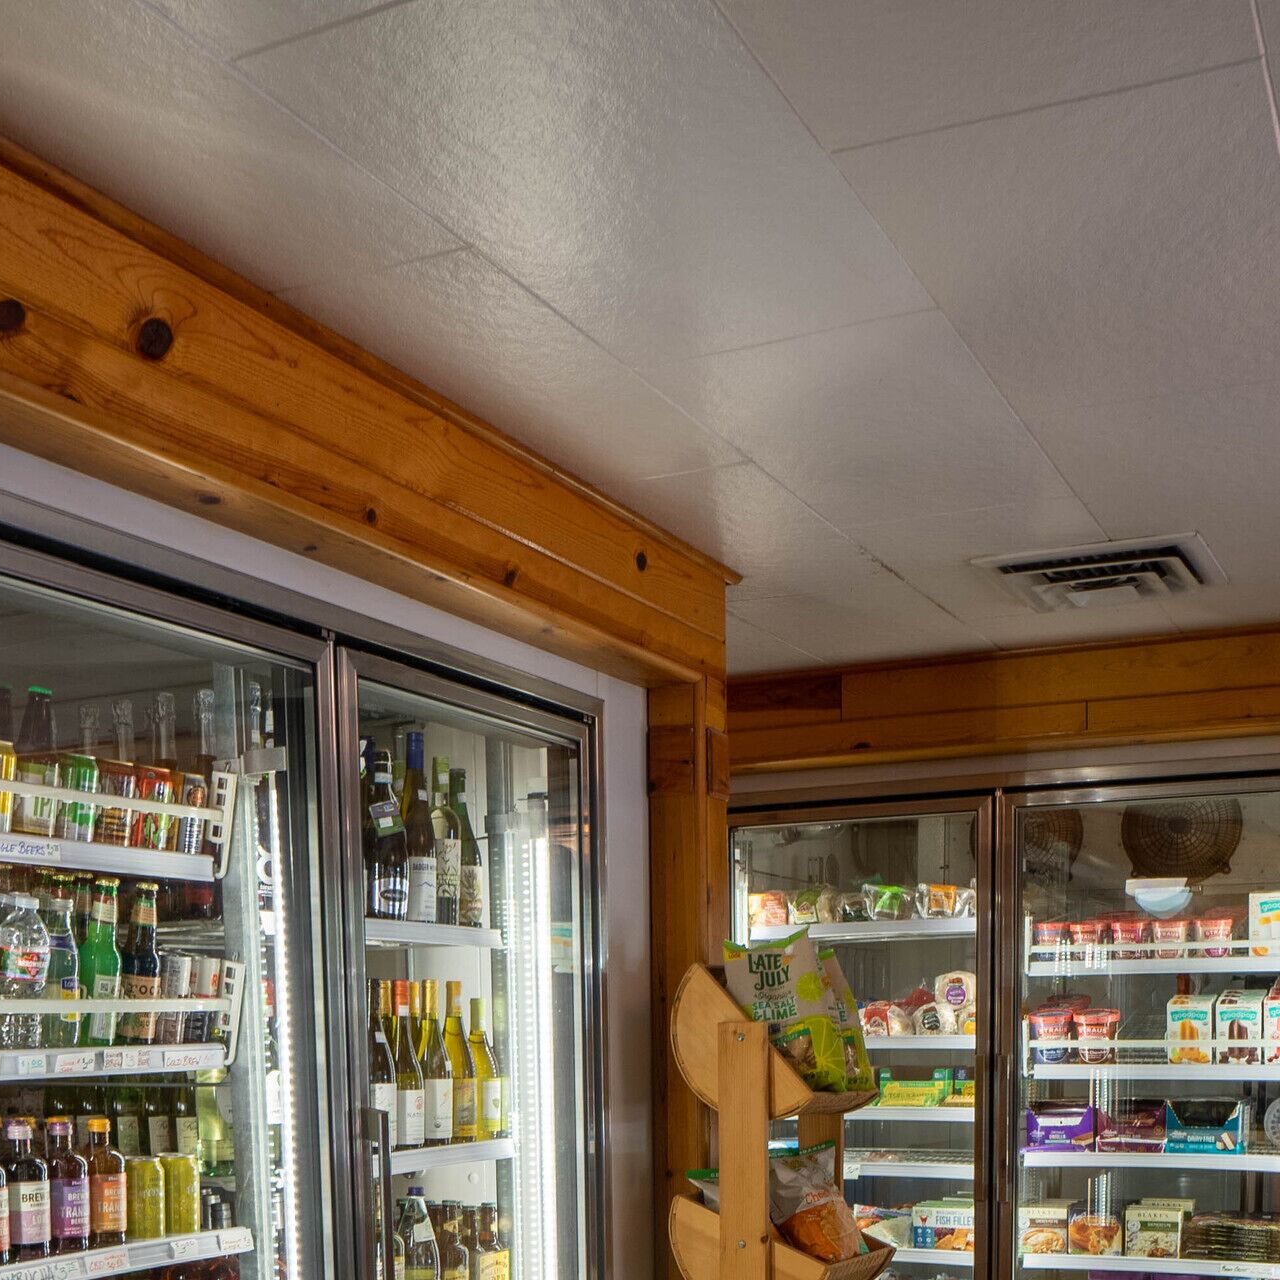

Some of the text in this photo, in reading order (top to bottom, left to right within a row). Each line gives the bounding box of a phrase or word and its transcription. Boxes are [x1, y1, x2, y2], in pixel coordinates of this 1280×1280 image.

[18, 843, 46, 856] BEERS
[748, 954, 783, 974] LATE
[754, 966, 791, 991] JULY
[752, 997, 796, 1011] SEA SALT
[1172, 1011, 1208, 1021] goodpop
[1220, 1011, 1256, 1021] goodpop
[935, 1215, 951, 1225] FISH
